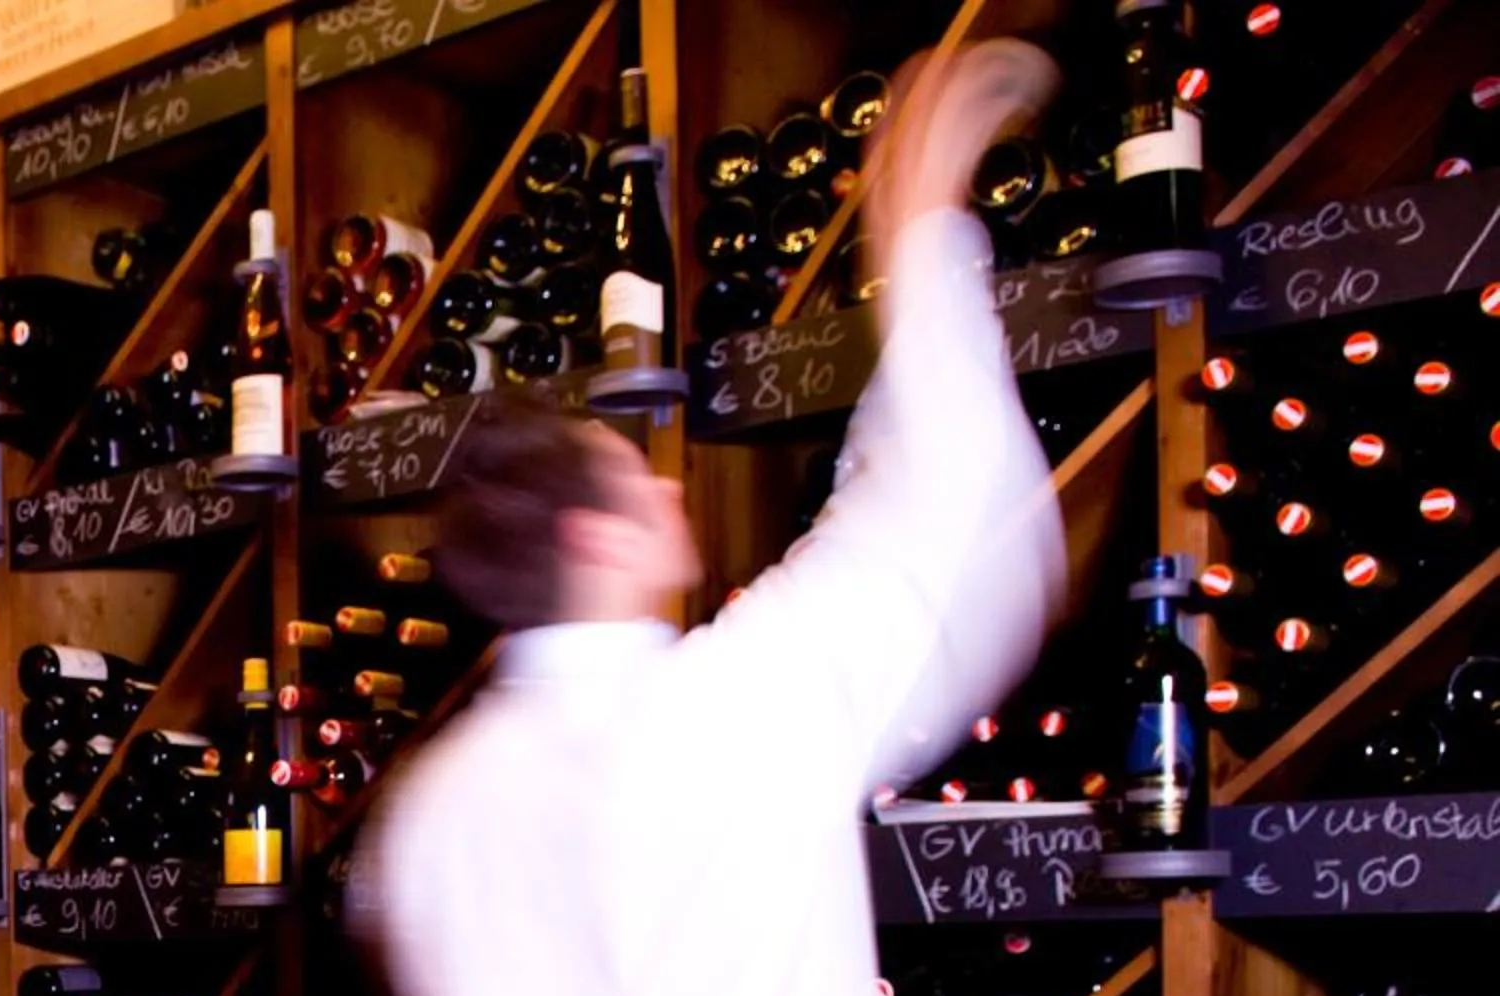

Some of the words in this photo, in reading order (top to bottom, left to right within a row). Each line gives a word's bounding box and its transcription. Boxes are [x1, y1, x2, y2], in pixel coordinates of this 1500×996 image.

[1236, 197, 1426, 259] Riesling
[1284, 266, 1380, 319] 6,10
[919, 824, 988, 861] GV
[1248, 804, 1319, 843] GV
[1312, 852, 1421, 910] 5,60
